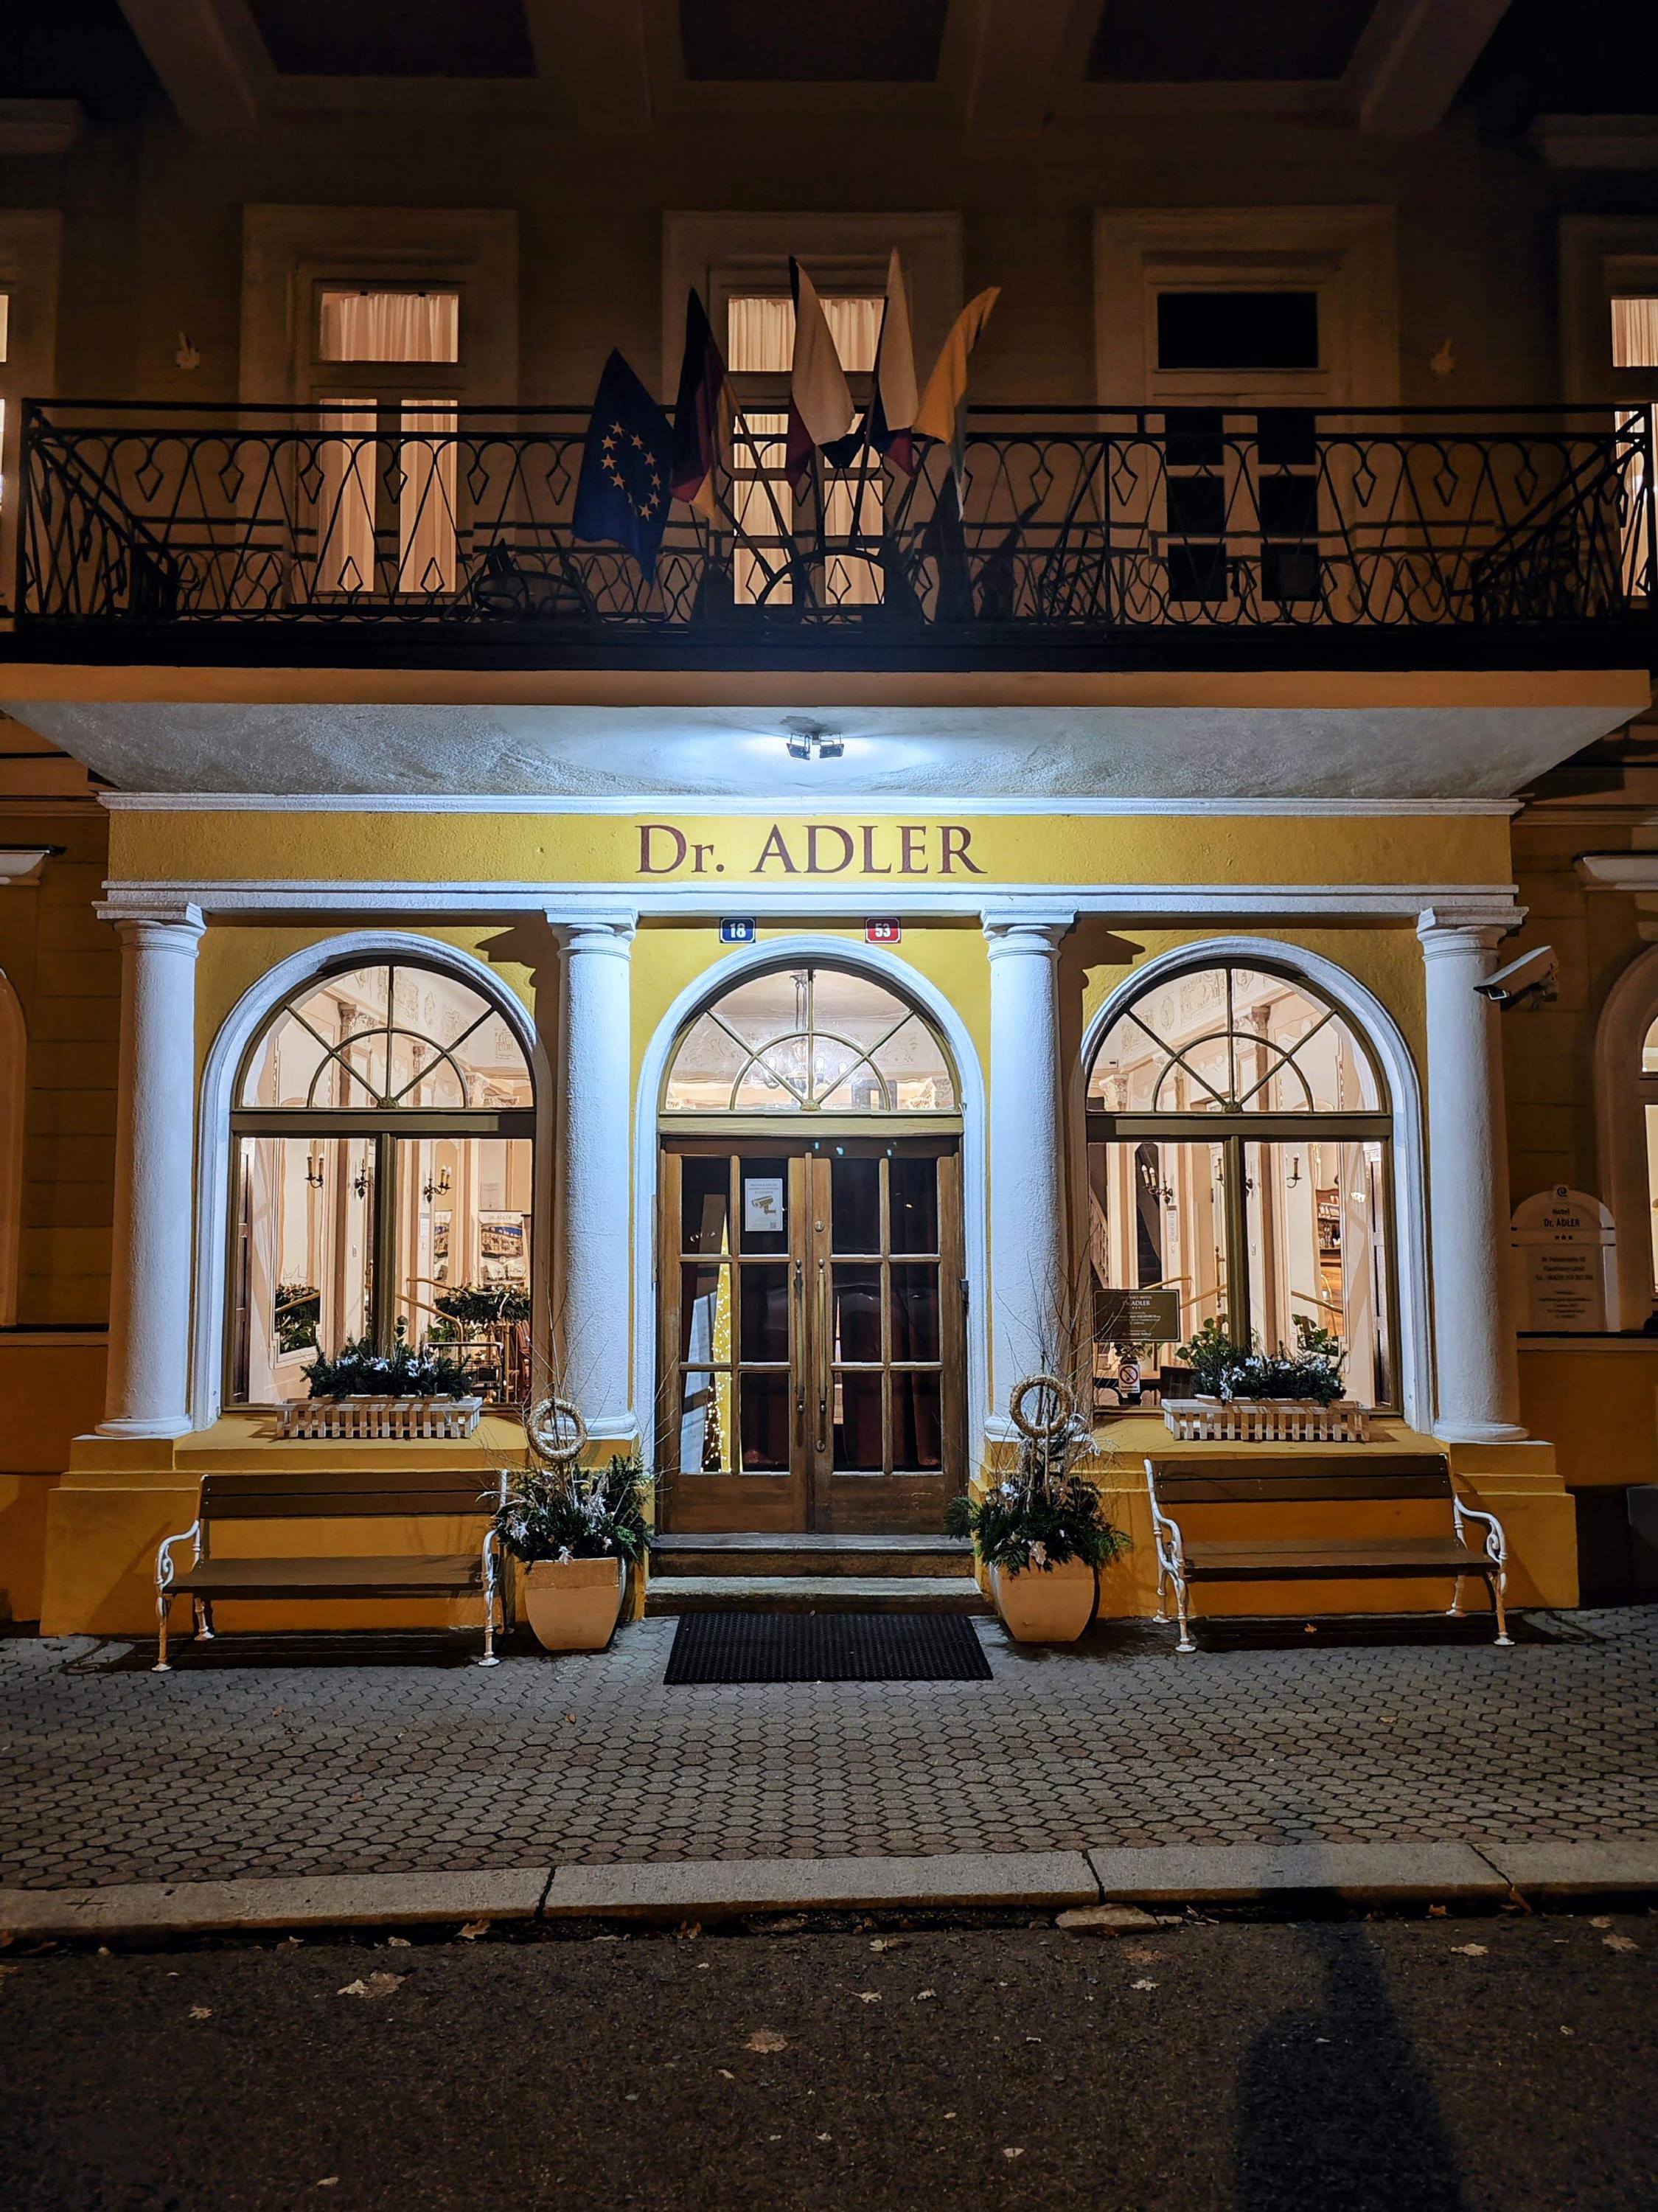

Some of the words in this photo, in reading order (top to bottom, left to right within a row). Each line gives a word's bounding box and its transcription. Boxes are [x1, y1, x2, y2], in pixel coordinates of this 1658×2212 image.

[635, 824, 725, 874] Dr.
[750, 824, 987, 874] ADLER
[729, 922, 746, 939] 18
[874, 922, 891, 939] 53
[1544, 1218, 1554, 1227] Dr.
[1556, 1218, 1580, 1227] ADLER
